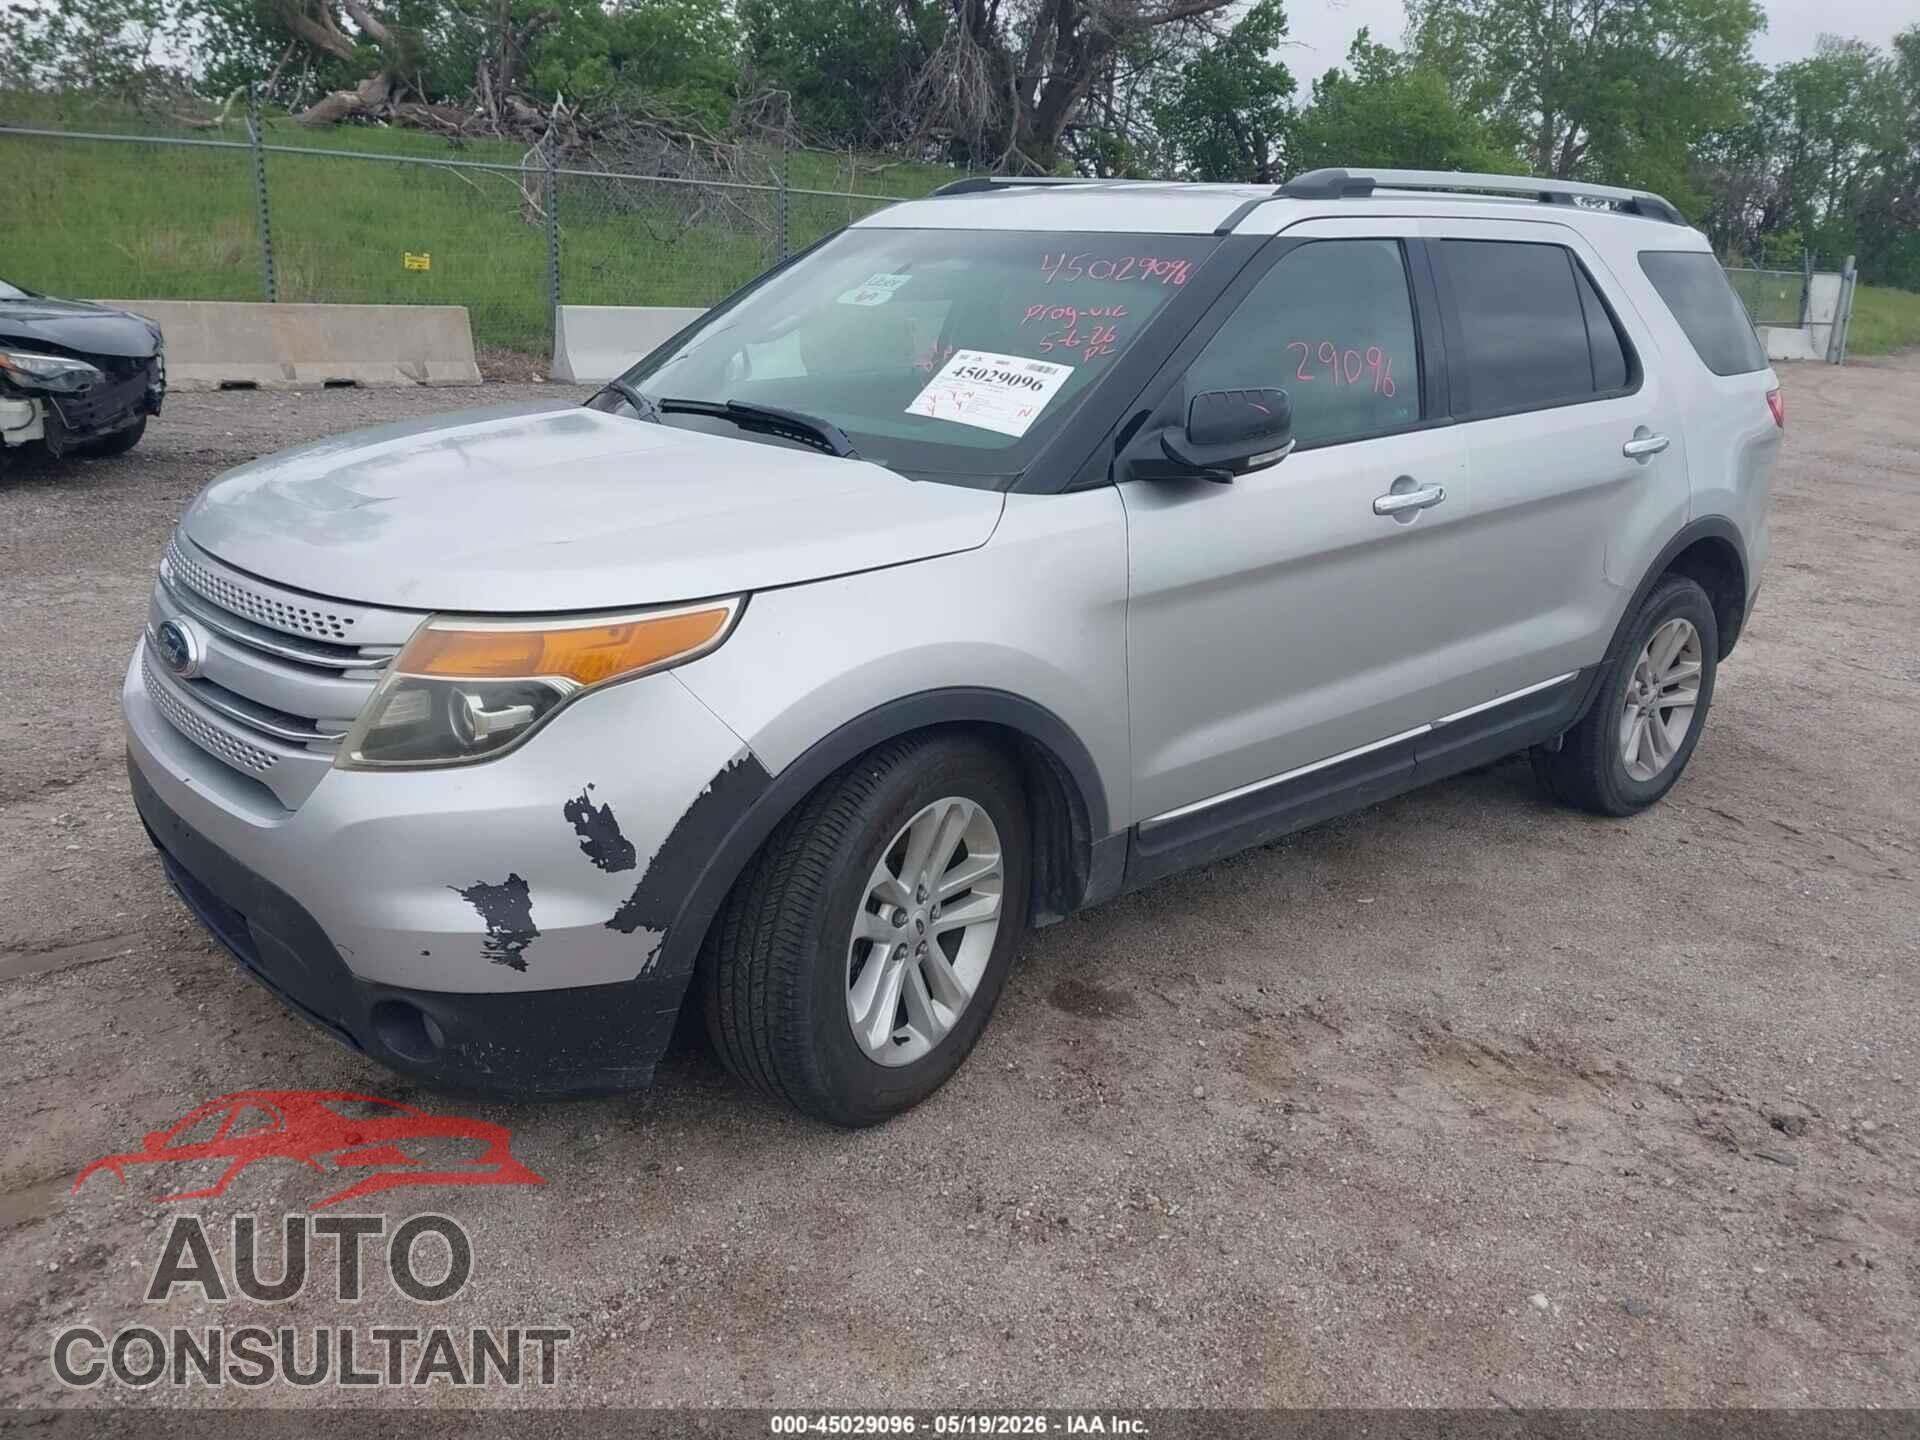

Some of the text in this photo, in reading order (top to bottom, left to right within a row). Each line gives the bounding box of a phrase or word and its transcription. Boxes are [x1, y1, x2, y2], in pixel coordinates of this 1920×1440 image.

[1041, 252, 1192, 285] 45029096
[952, 366, 1044, 392] 45029096
[1287, 341, 1396, 397] 29096
